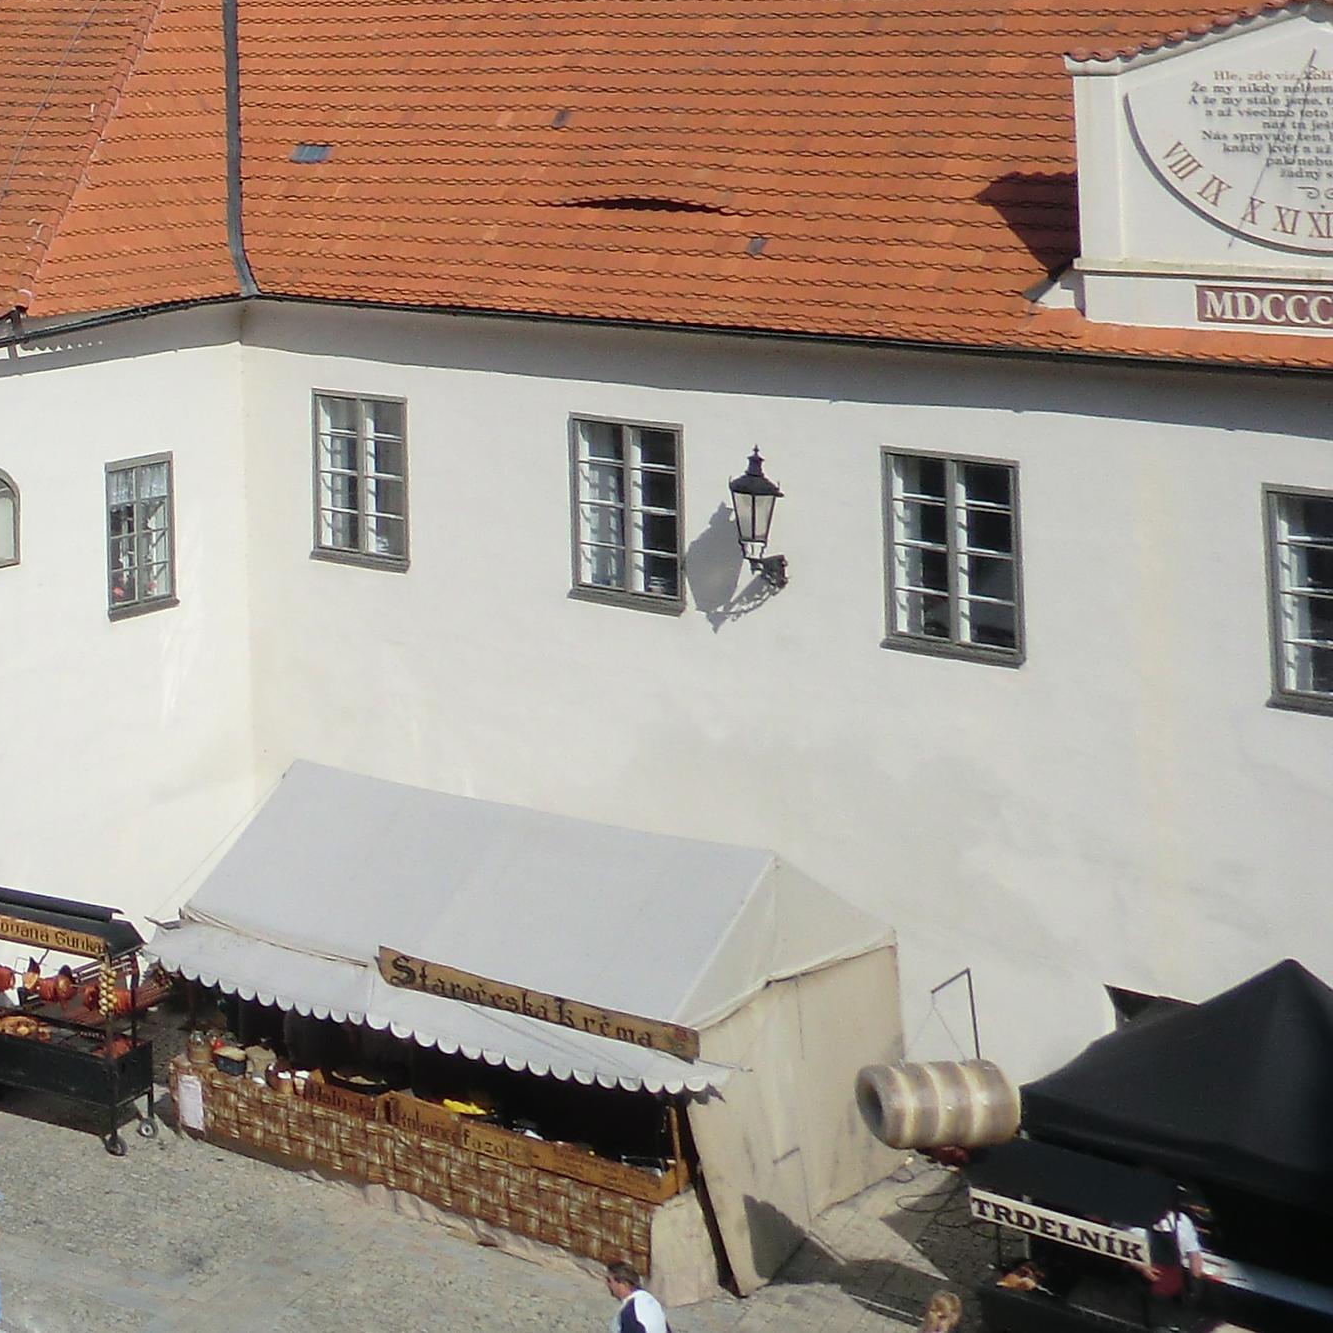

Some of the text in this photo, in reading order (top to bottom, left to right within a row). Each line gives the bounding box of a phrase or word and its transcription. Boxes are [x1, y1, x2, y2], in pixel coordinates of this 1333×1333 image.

[1162, 141, 1204, 180] VIII
[1196, 173, 1233, 207] IX
[1271, 204, 1301, 236] XI
[1203, 290, 1333, 325] MDCCC
[972, 1197, 1145, 1263] TRDELNÍK
